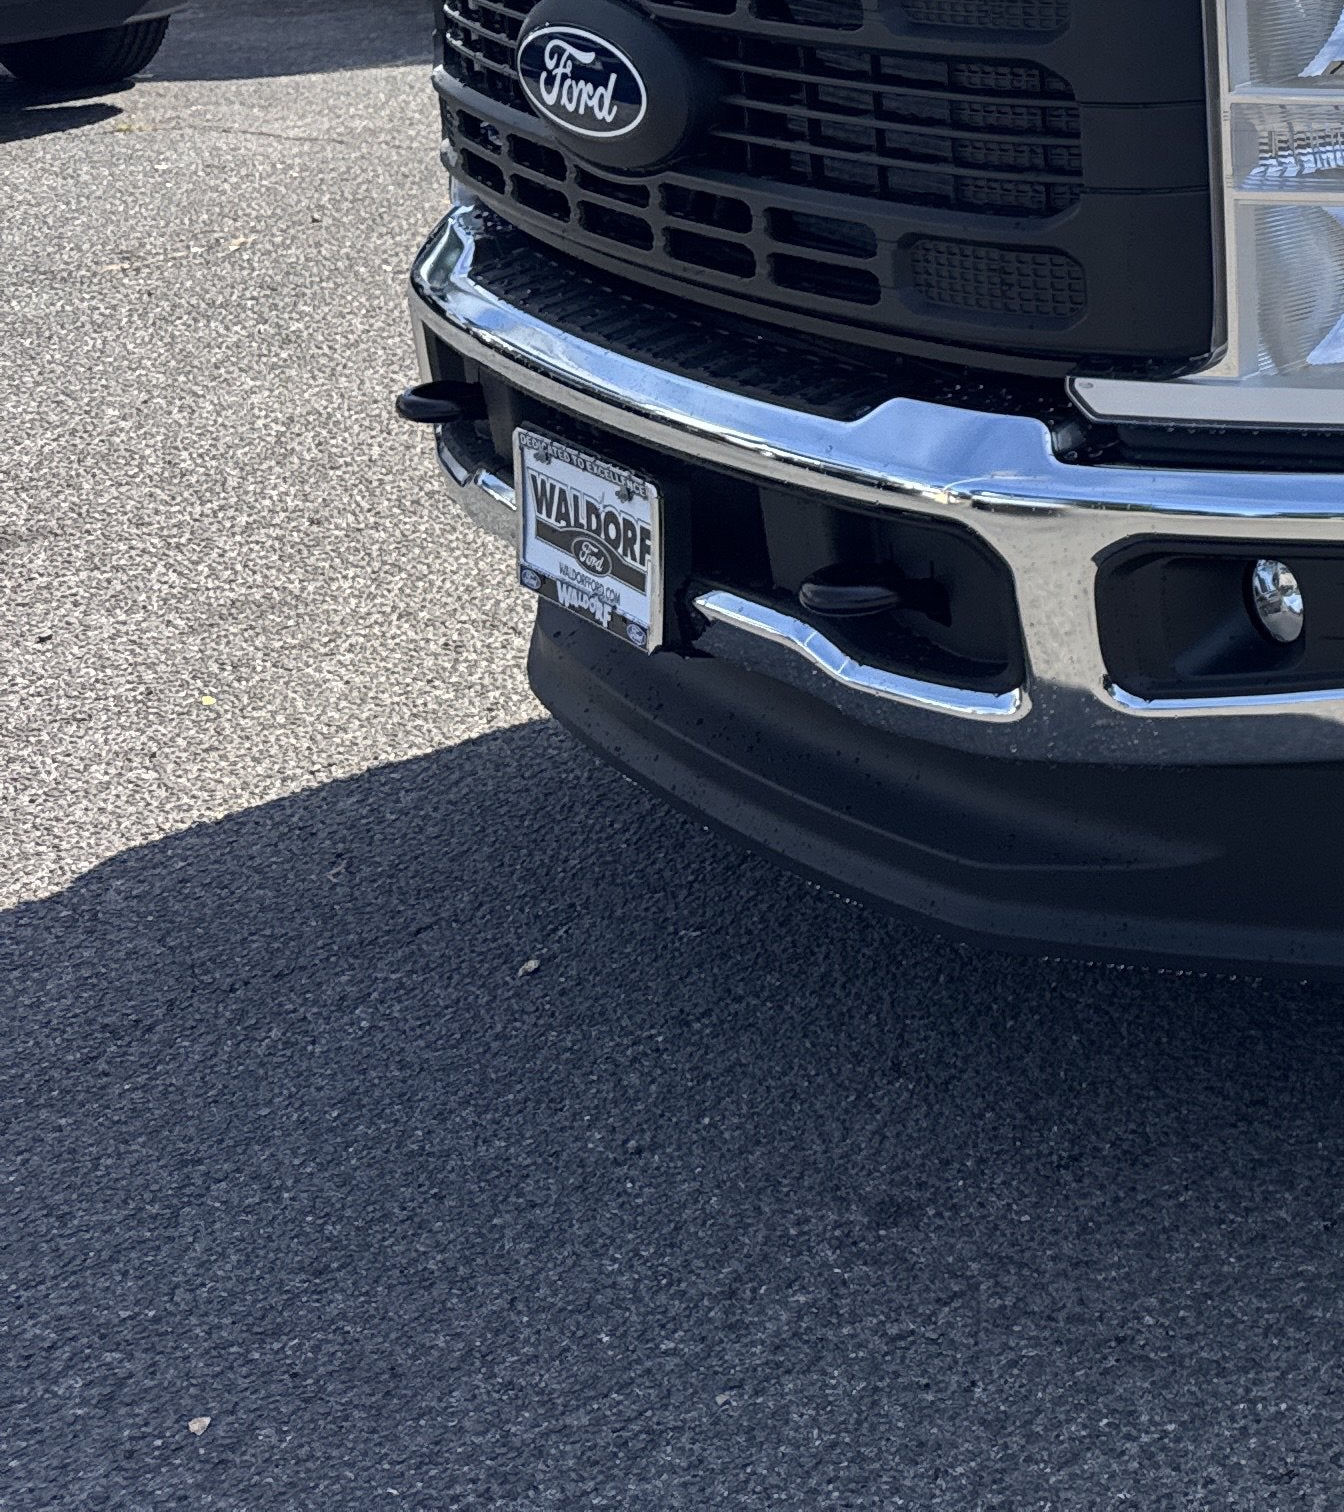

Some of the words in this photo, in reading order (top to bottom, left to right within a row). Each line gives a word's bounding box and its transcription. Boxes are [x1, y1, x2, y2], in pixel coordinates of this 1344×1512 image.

[539, 38, 618, 123] Ford
[519, 434, 571, 463] DEDICATED
[572, 453, 585, 470] TO
[586, 459, 647, 497] EXCELLENCE
[529, 472, 651, 568] WALDORF
[579, 541, 605, 574] Ford
[557, 579, 614, 628] WALDORF
